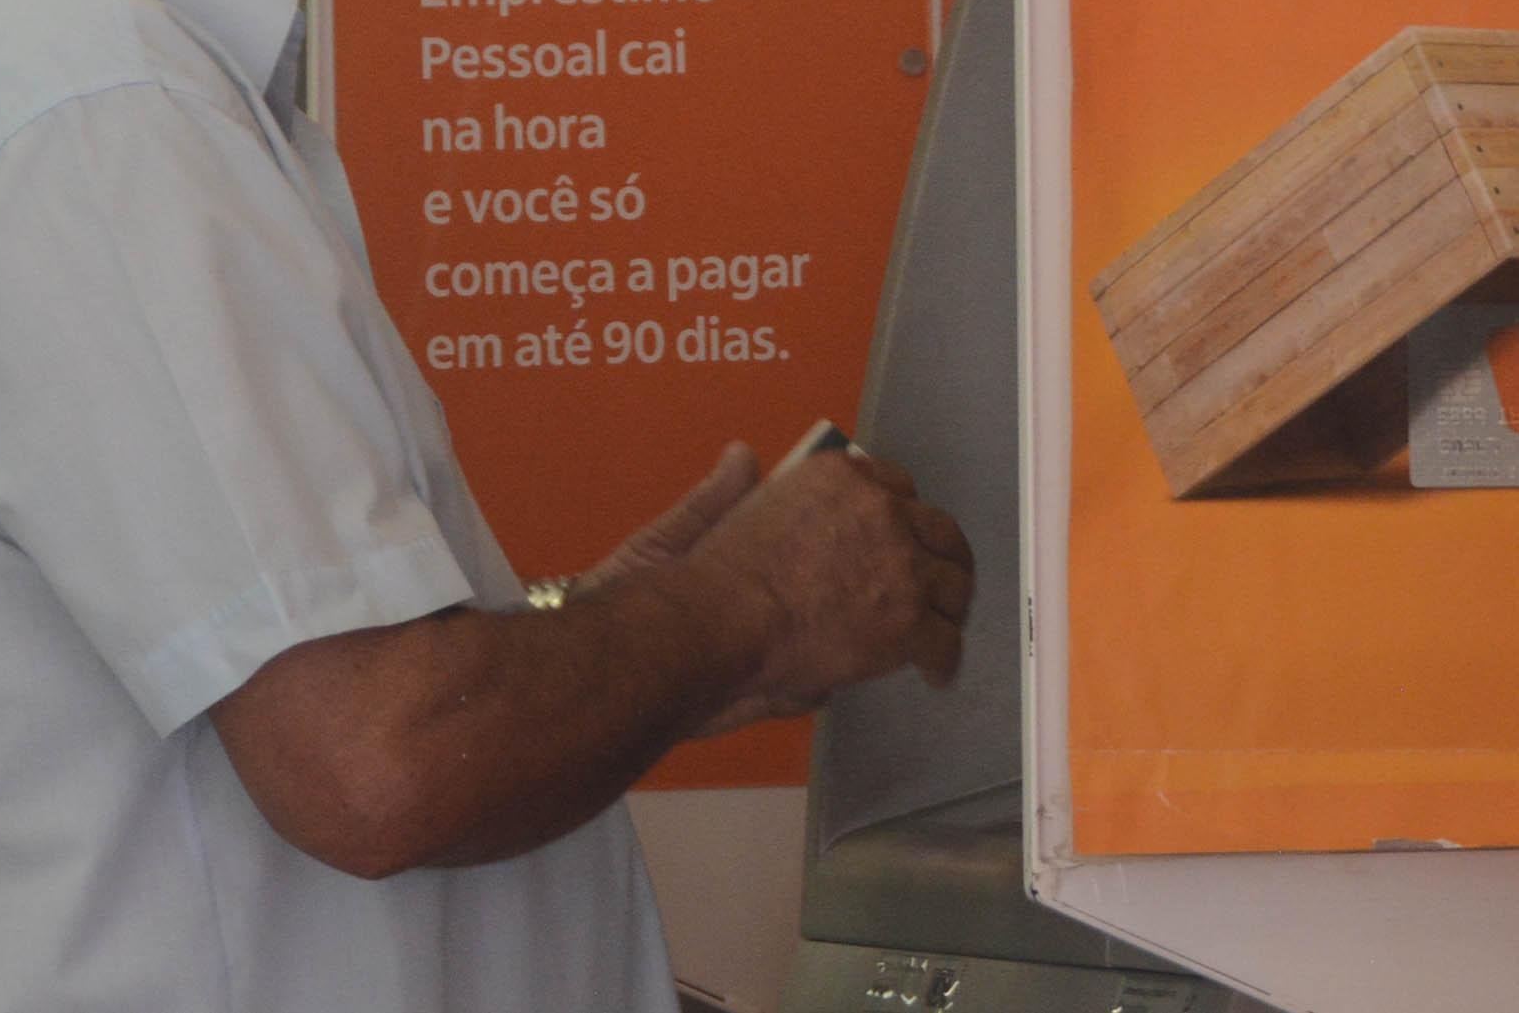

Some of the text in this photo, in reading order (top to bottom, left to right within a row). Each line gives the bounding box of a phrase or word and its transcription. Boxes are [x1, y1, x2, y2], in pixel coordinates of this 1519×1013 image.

[422, 28, 687, 80] Pessoal cai
[423, 103, 607, 152] na hora
[423, 173, 646, 224] e você só
[425, 252, 811, 308] começa a pagar
[426, 316, 791, 369] em até 90 dias.
